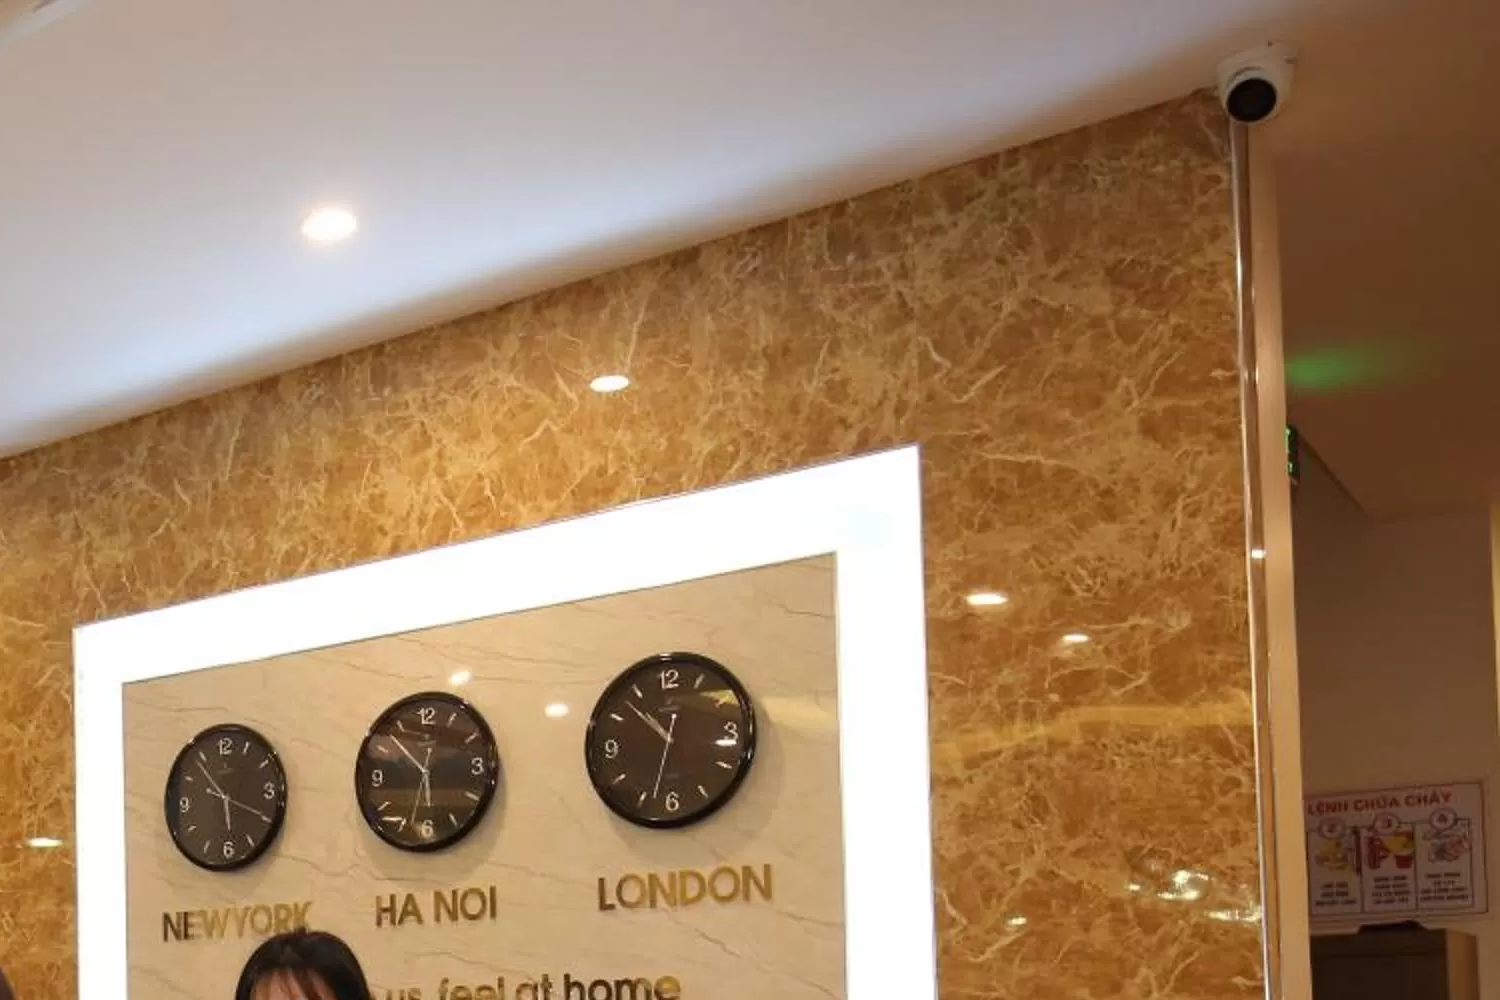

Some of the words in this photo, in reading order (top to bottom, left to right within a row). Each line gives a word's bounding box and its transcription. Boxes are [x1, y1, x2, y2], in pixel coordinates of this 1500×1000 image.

[661, 669, 680, 689] 12
[416, 707, 436, 725] 12
[604, 739, 619, 760] 9
[470, 757, 484, 775] 3
[371, 769, 383, 787] 9
[179, 796, 190, 813] 9
[665, 791, 680, 812] 6
[421, 819, 434, 838] 6
[222, 841, 234, 858] 6
[598, 863, 773, 911] LONDON
